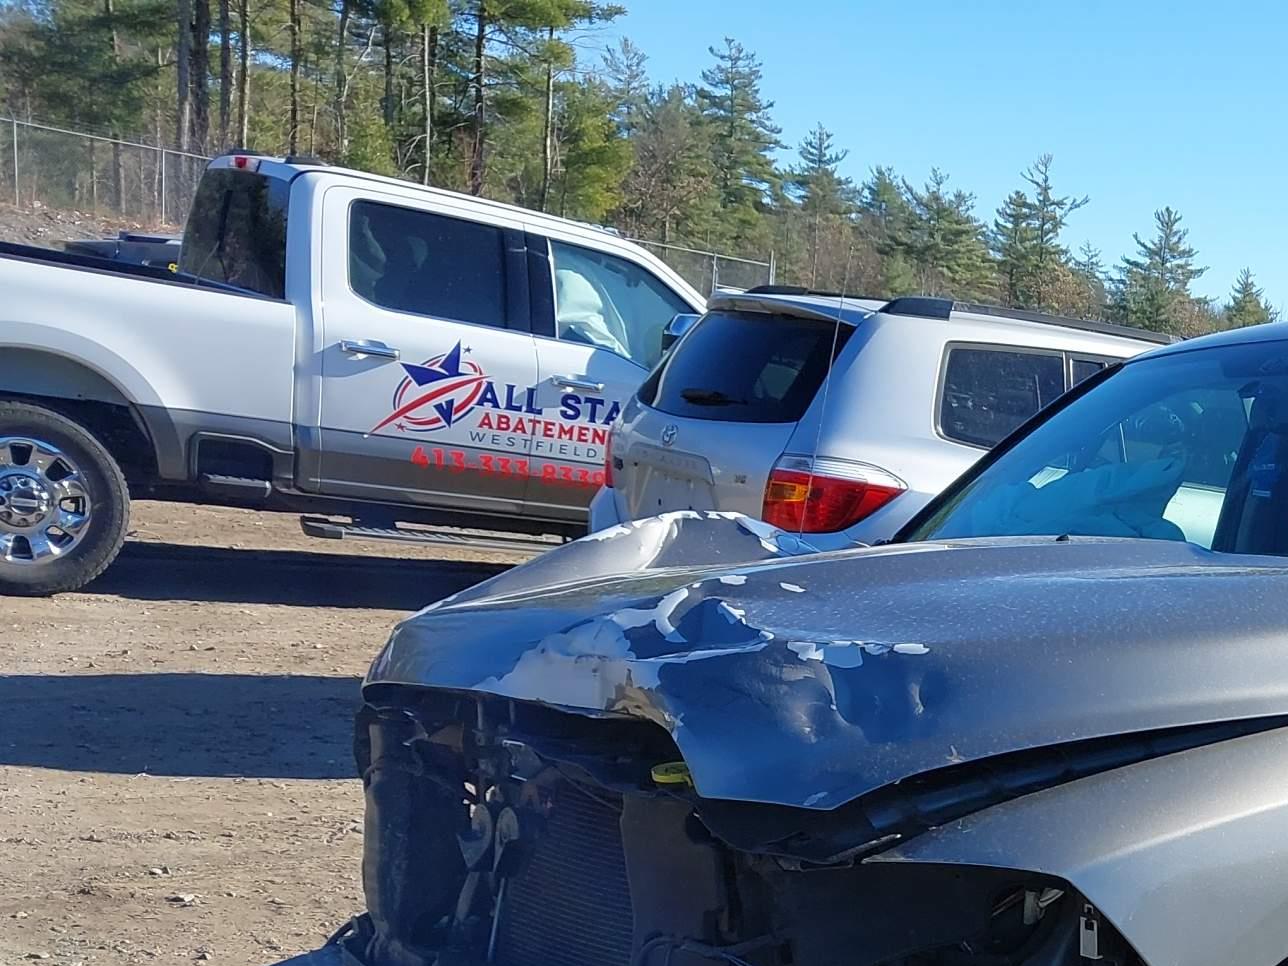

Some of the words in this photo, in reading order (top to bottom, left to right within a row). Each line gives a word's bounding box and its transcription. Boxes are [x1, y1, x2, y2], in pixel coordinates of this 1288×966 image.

[474, 380, 543, 416] ALL
[559, 393, 622, 426] STA
[478, 411, 609, 446] ABATEMEN
